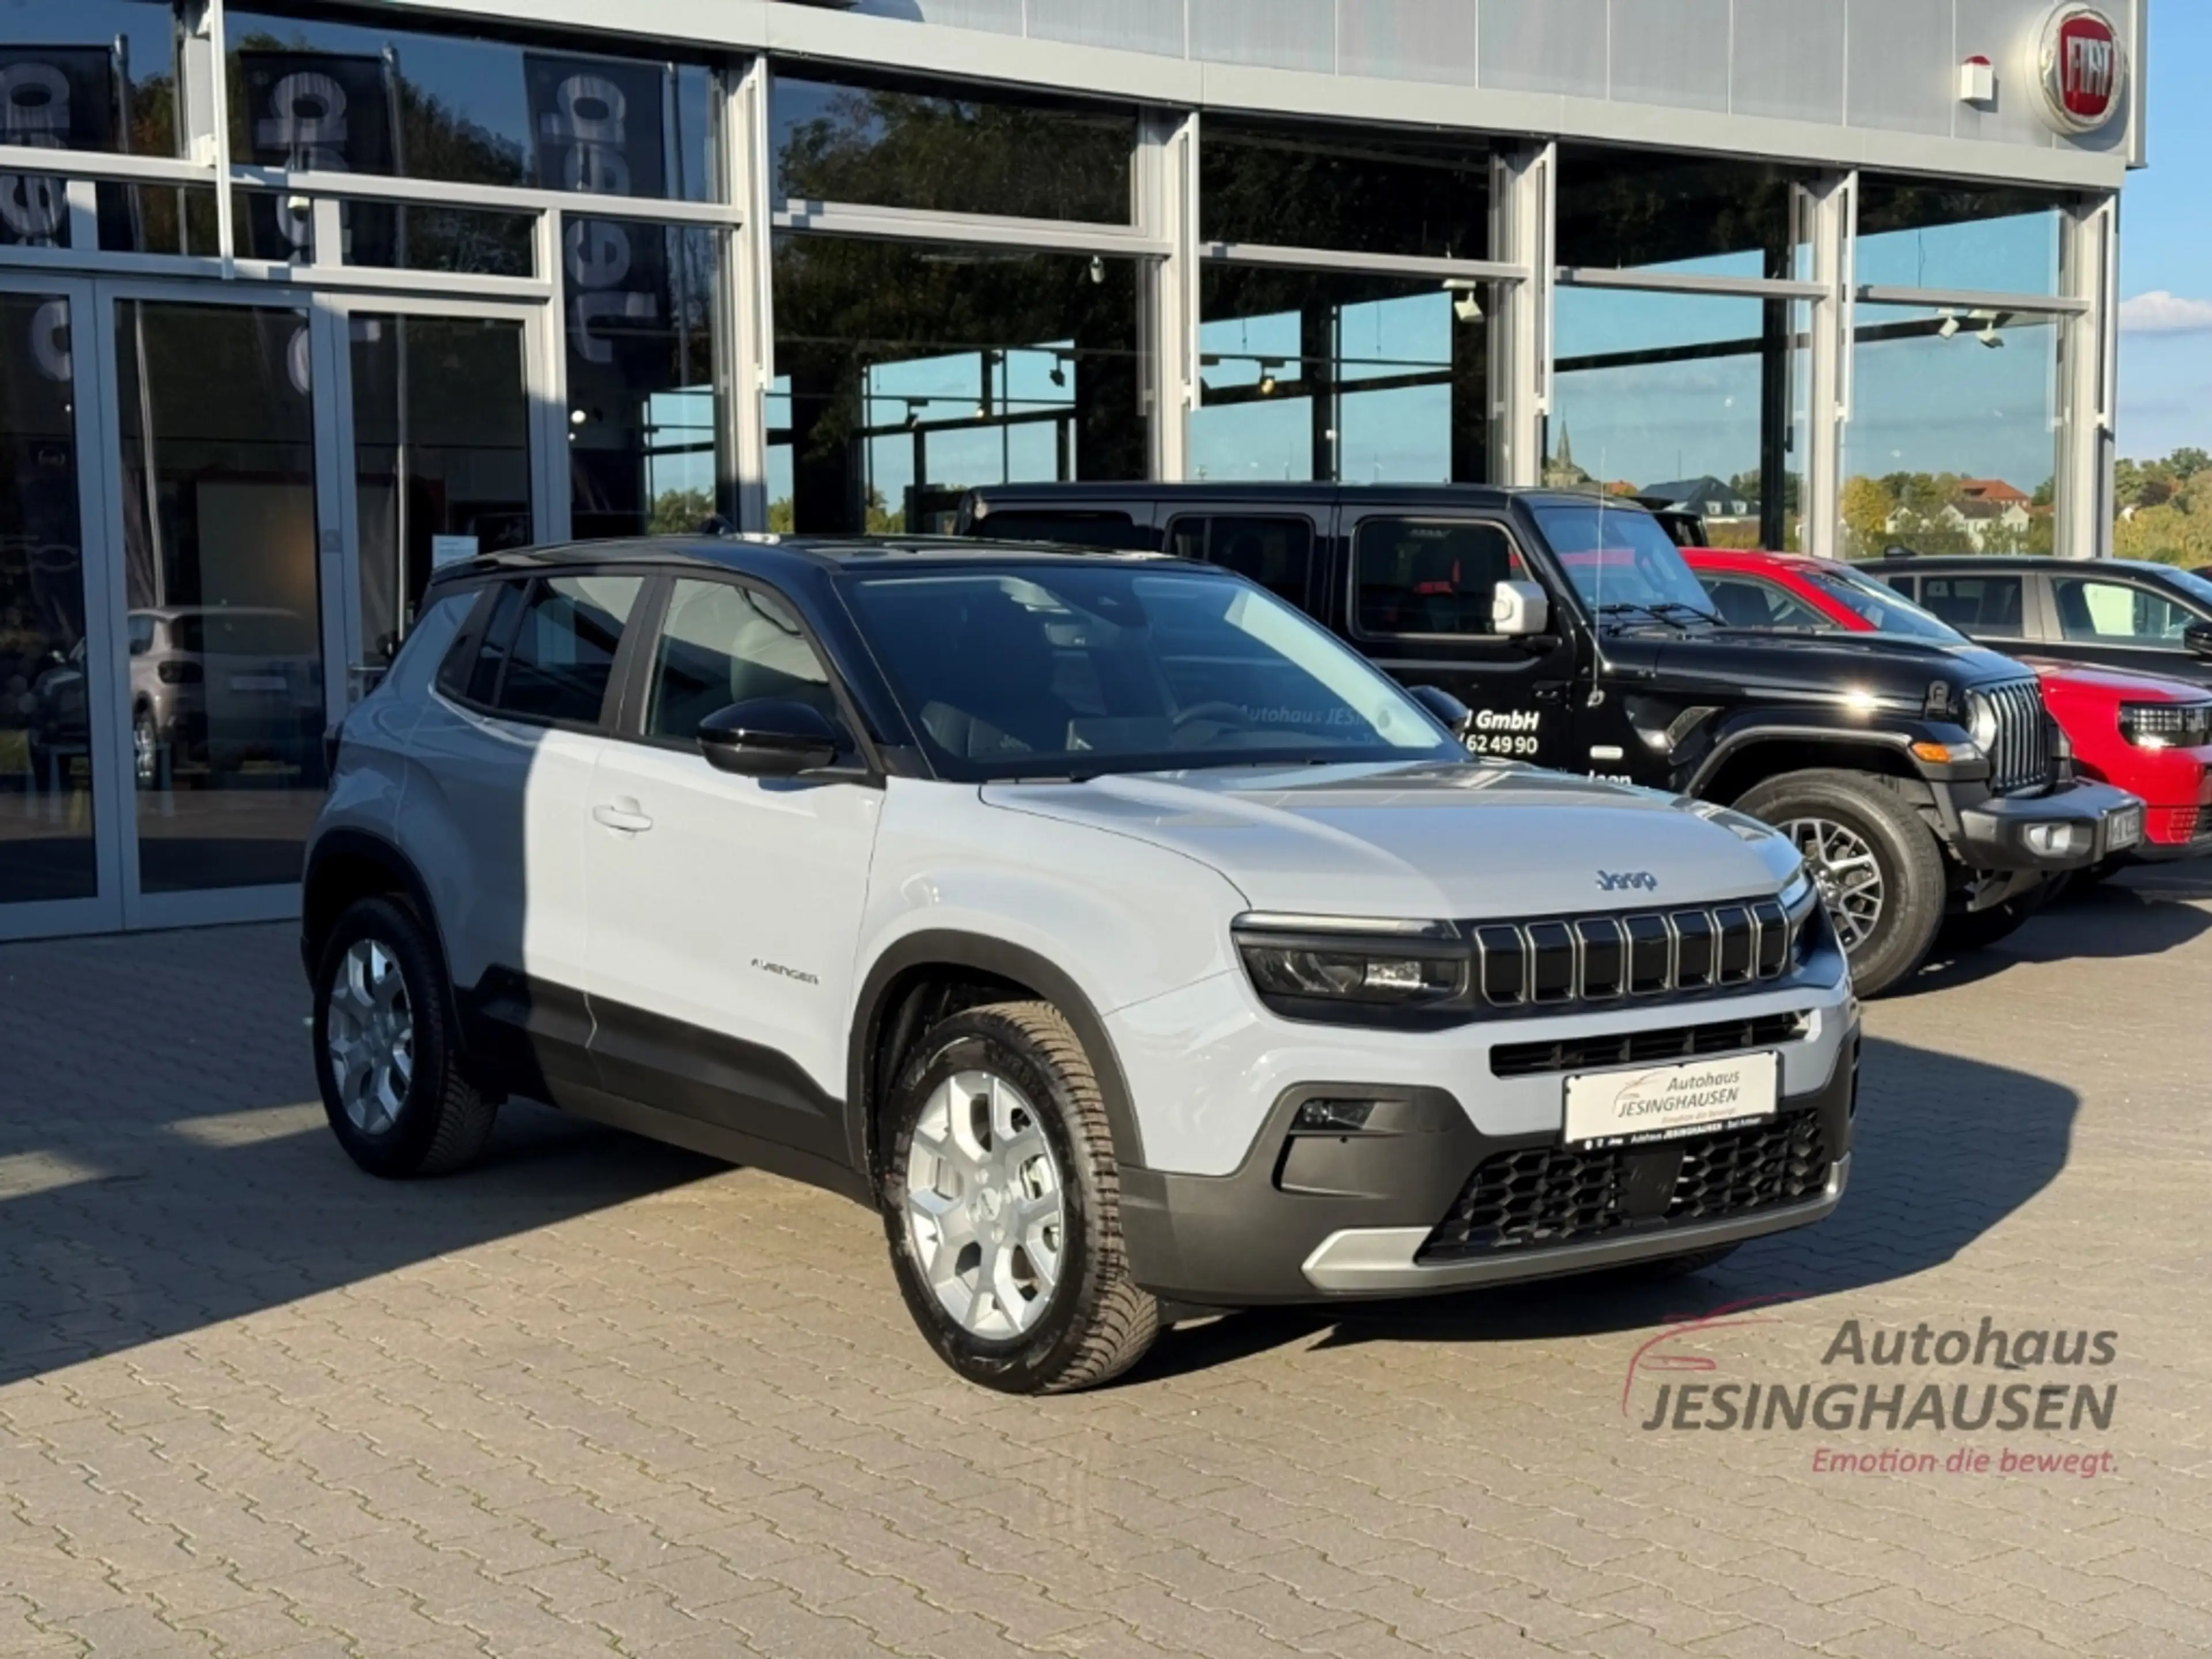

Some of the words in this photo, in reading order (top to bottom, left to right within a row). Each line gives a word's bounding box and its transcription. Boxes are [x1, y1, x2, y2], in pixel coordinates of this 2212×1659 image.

[2067, 36, 2111, 97] FIAT
[1476, 709, 1540, 731] GmbH
[1666, 1071, 1740, 1092] Autohaus
[1618, 1087, 1740, 1118] JESINGHAUSEN
